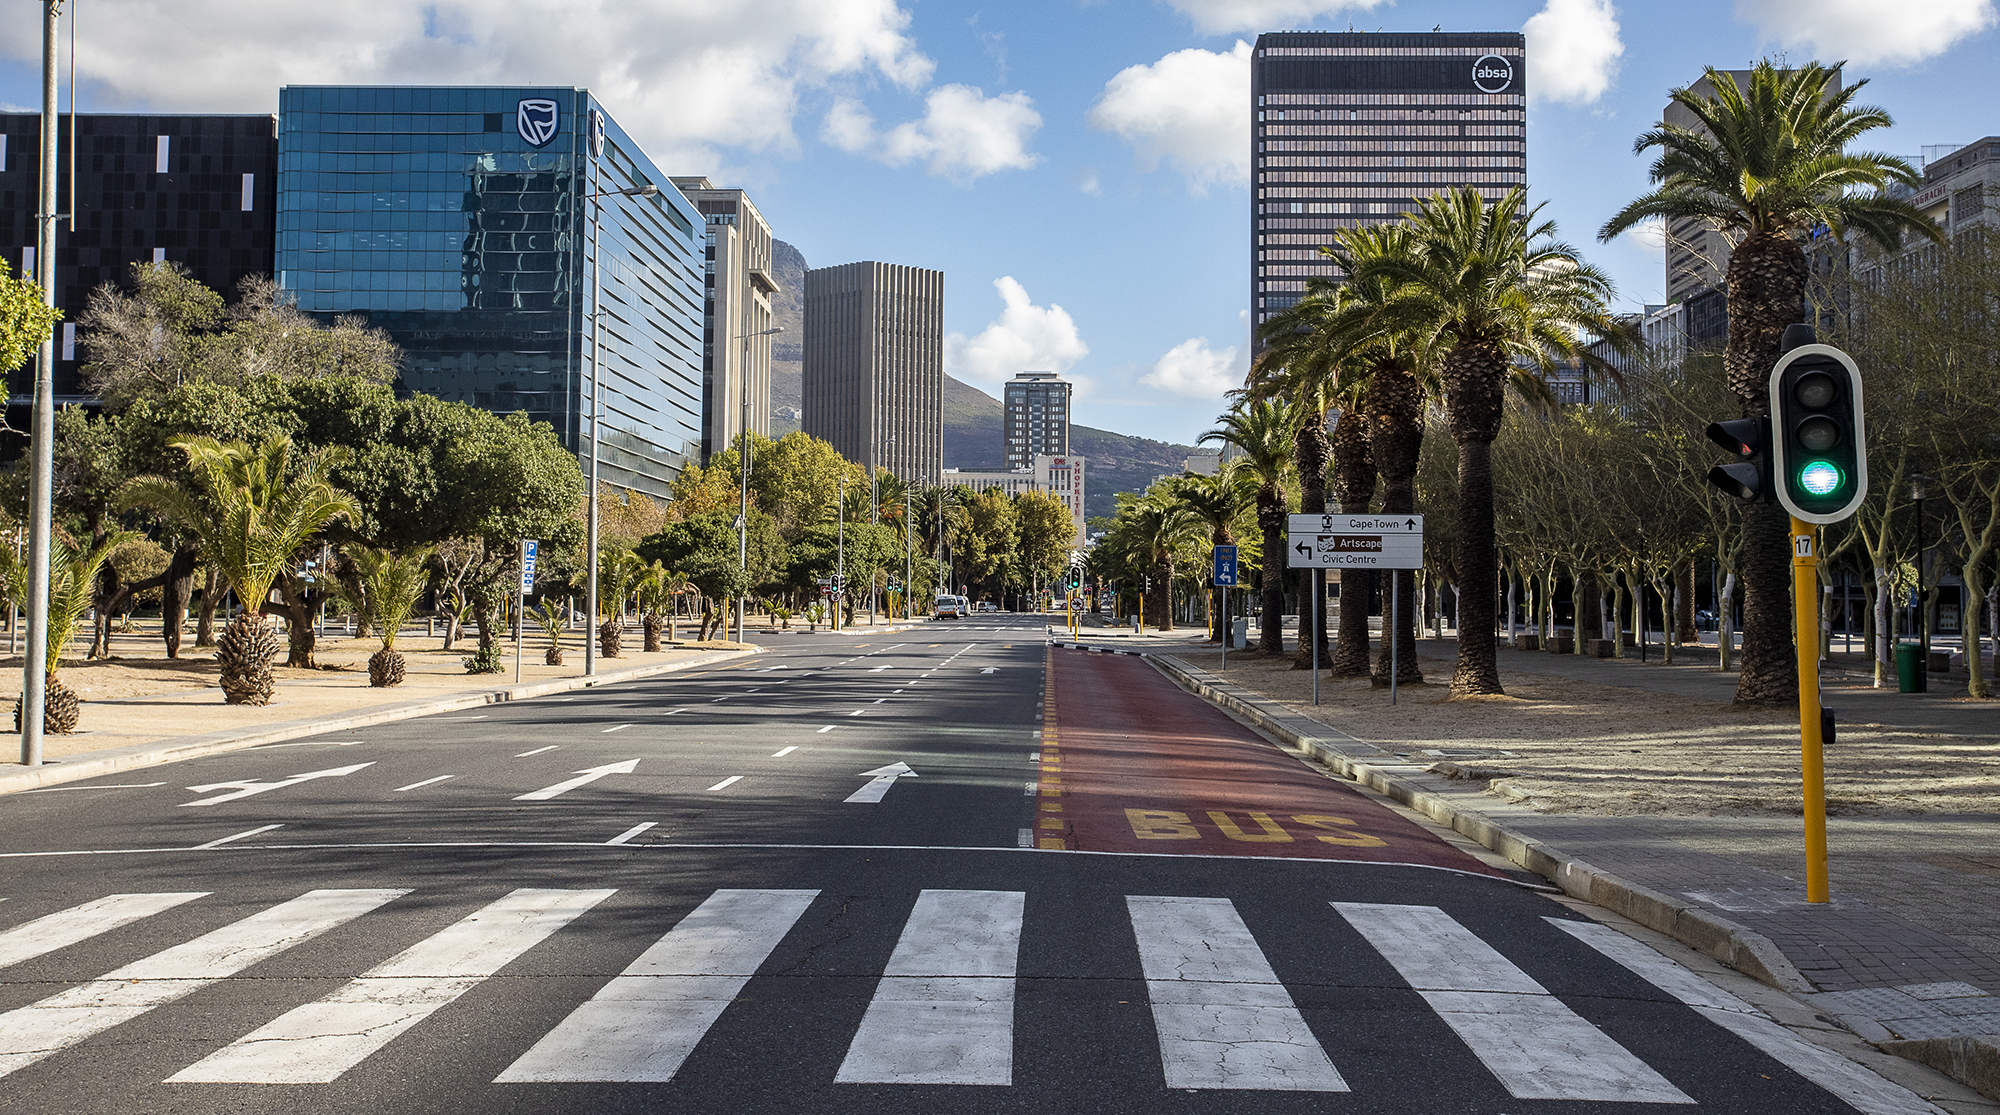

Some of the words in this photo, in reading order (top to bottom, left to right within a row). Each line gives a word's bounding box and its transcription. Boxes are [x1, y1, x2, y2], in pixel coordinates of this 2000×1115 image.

[1477, 65, 1508, 78] absa
[1910, 184, 1947, 206] ENGRACHT
[1349, 519, 1373, 530] Cape
[1374, 519, 1399, 529] Town
[528, 543, 535, 553] P
[1340, 538, 1382, 550] Artscape
[1795, 538, 1810, 554] 17
[1322, 554, 1344, 564] Civic
[1346, 554, 1377, 564] Centre
[1124, 808, 1389, 847] BUS
